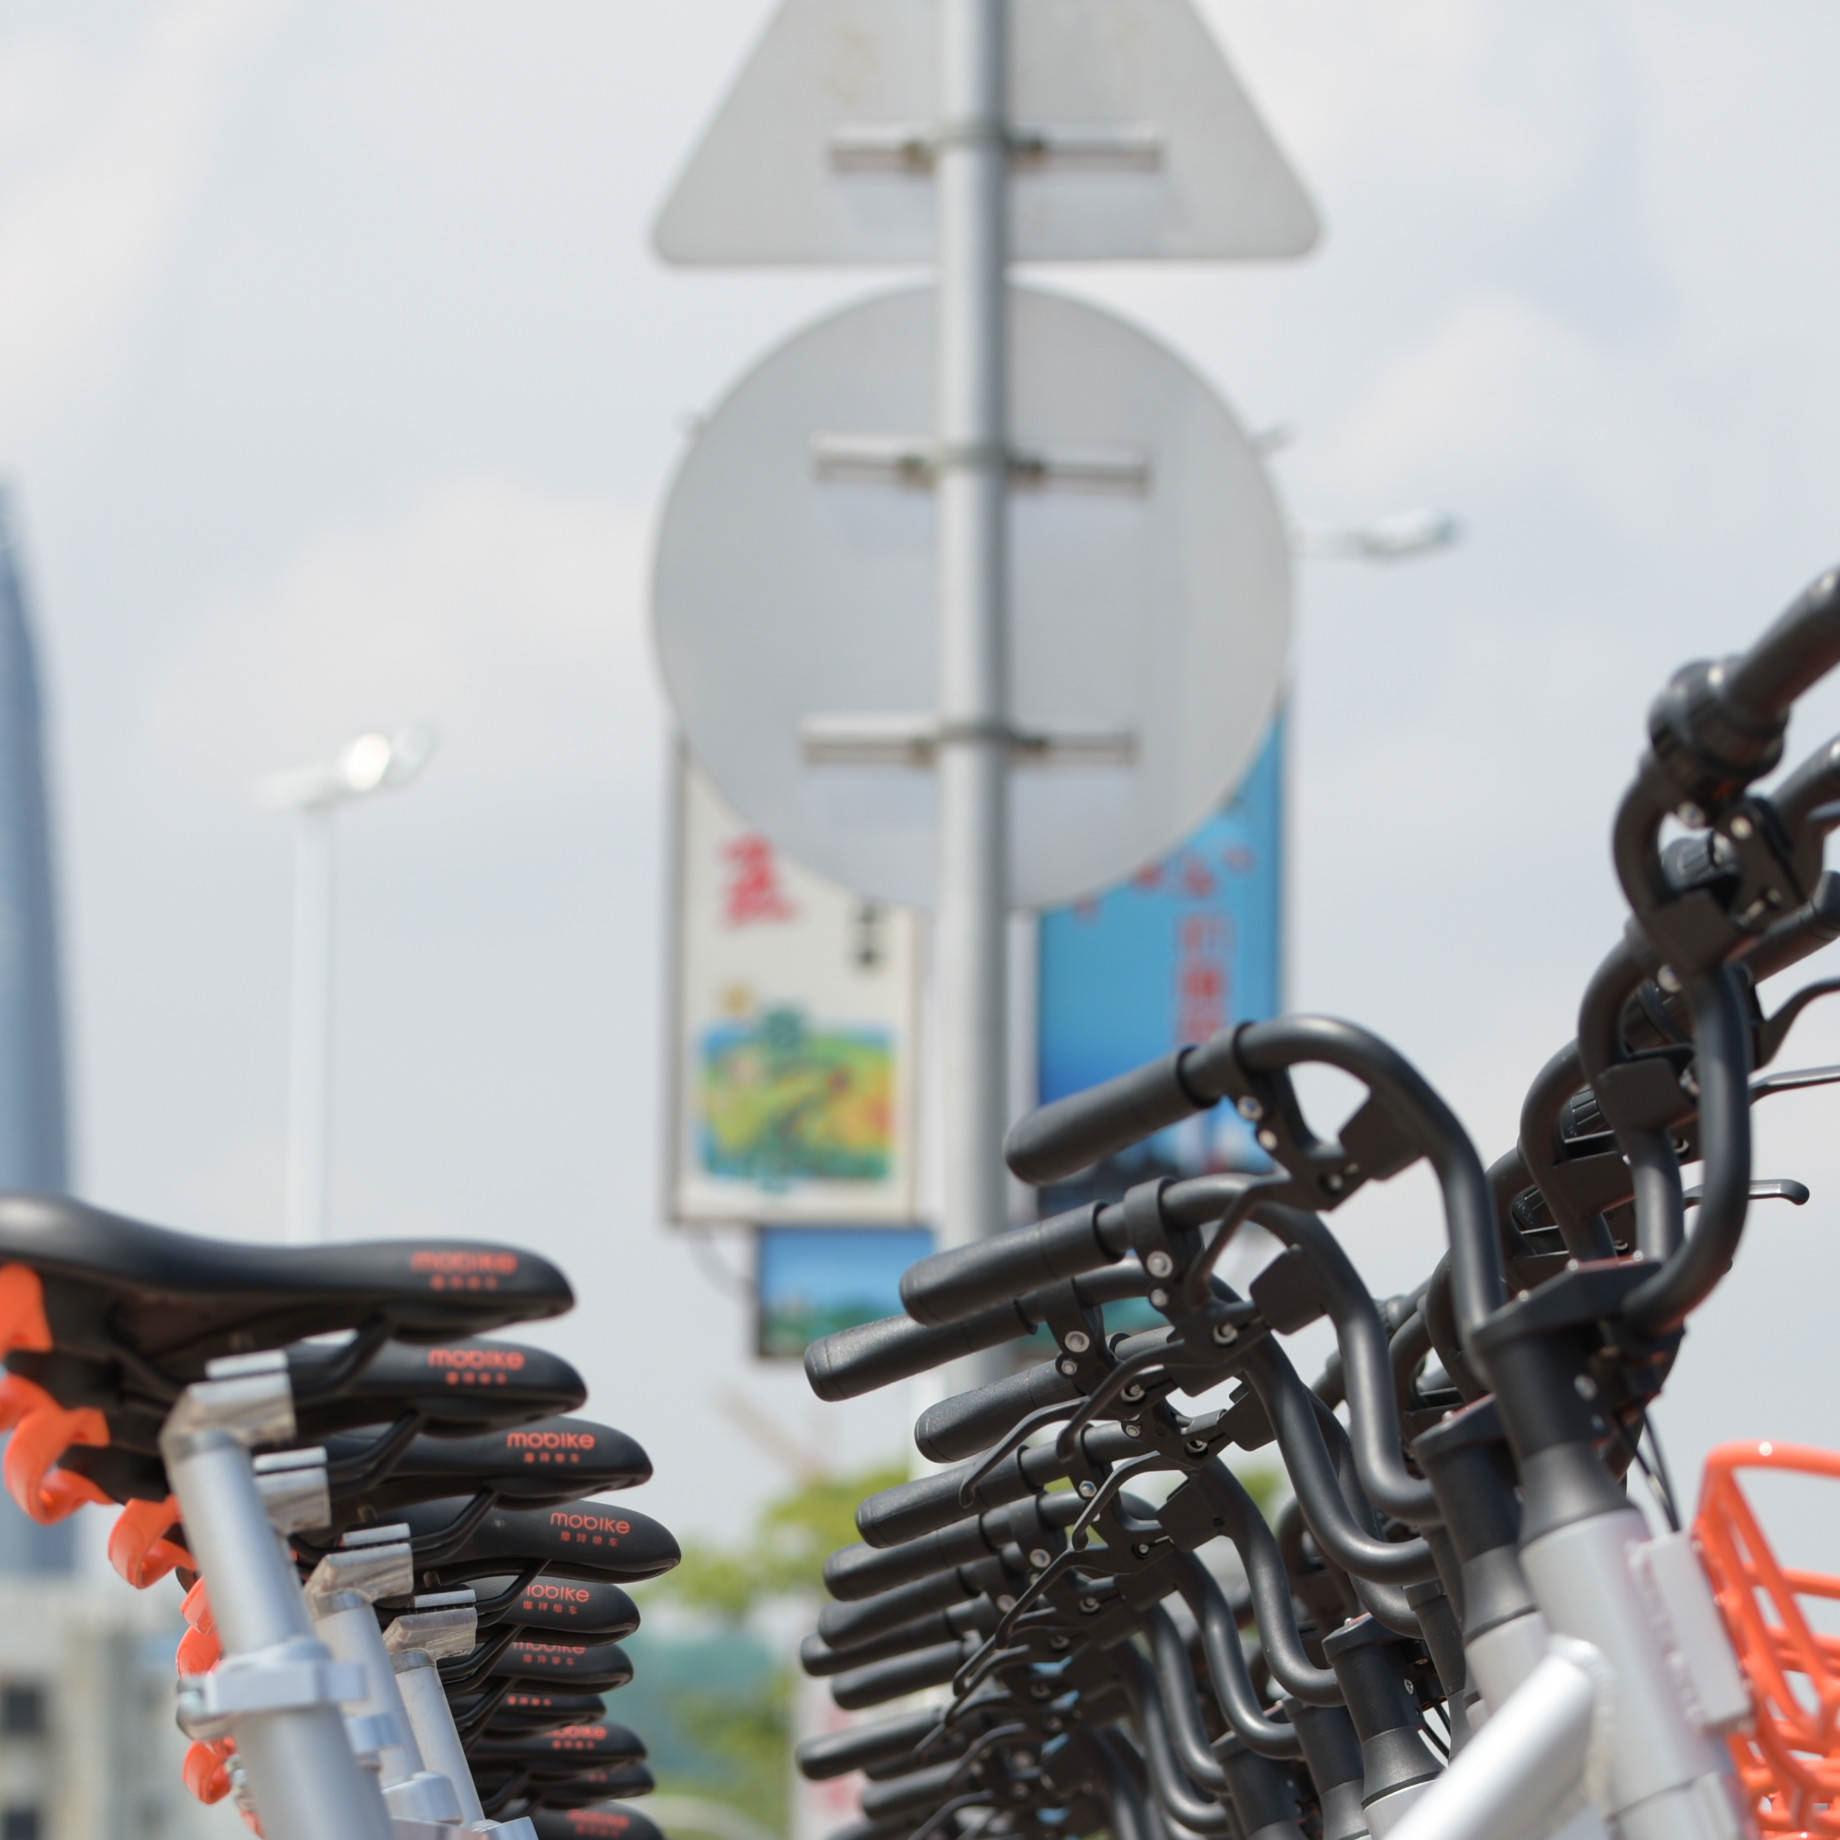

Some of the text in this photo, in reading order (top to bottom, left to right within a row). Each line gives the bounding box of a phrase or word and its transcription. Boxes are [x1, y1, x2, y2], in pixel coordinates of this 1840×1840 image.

[506, 1431, 596, 1449] mobike
[549, 1511, 631, 1535] mobike
[527, 1584, 590, 1603] obike
